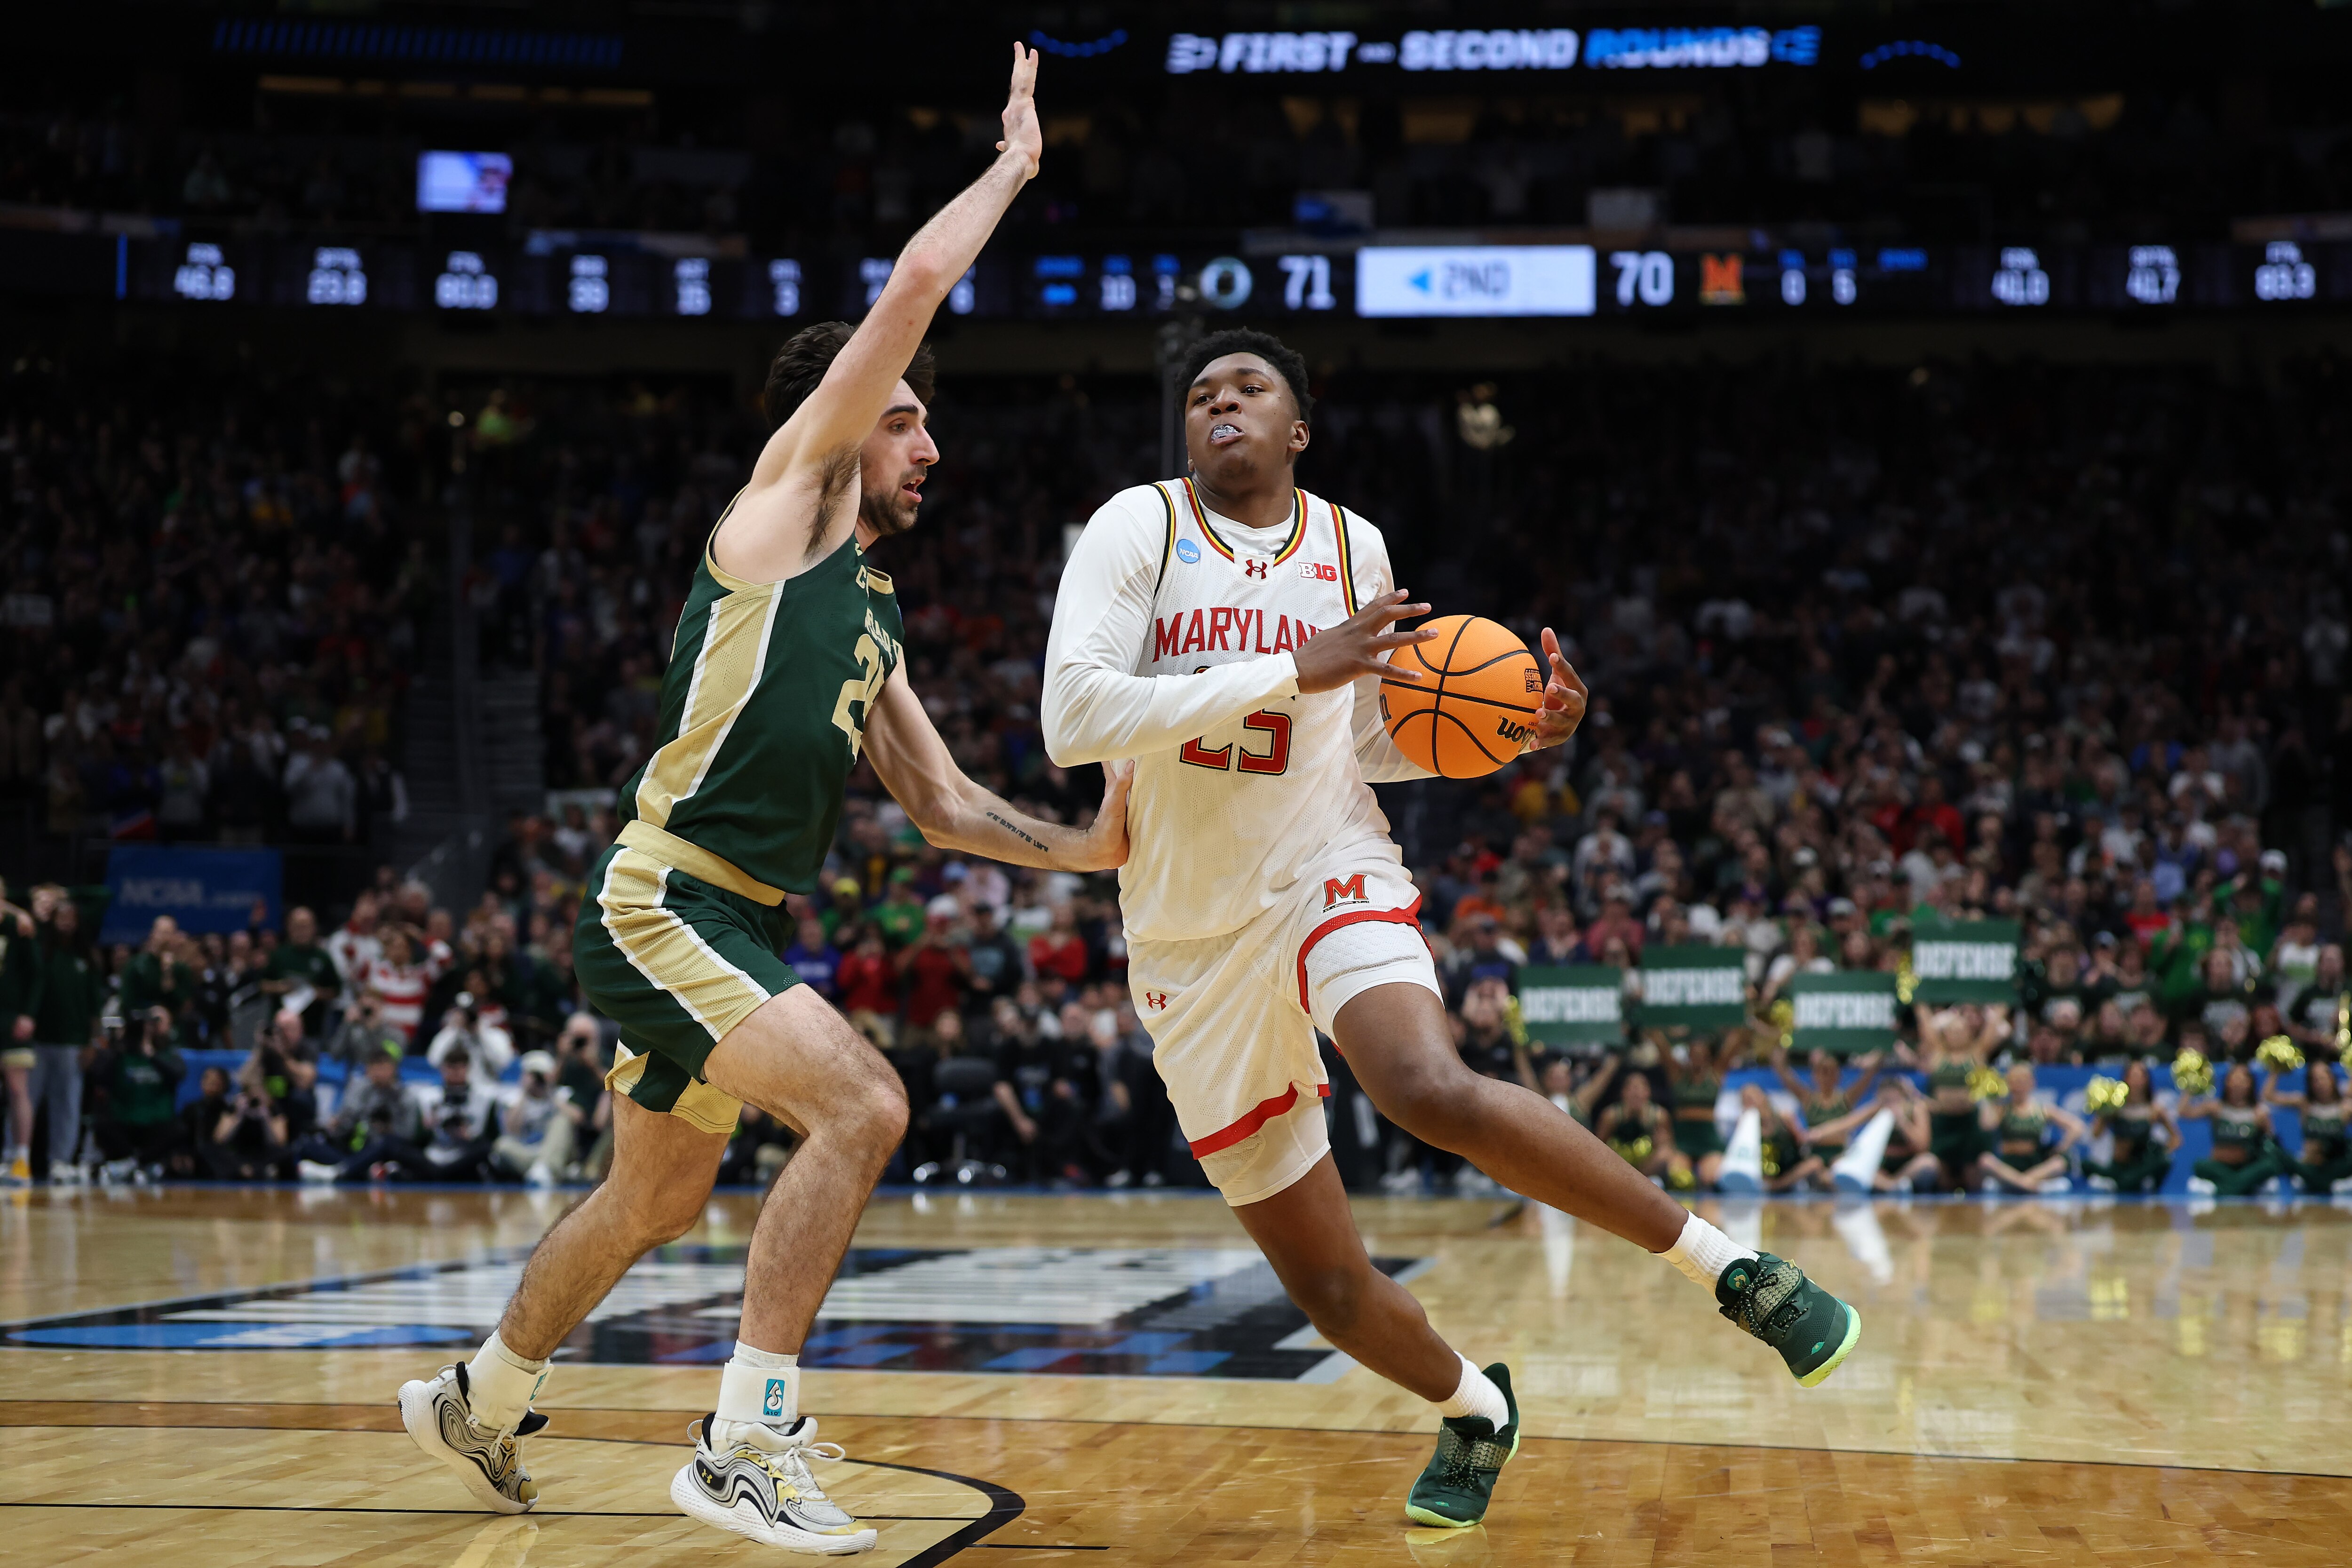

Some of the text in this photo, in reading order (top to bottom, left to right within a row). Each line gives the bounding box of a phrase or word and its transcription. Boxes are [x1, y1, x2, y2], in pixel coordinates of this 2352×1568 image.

[1218, 32, 1356, 72] FIRST
[1399, 29, 1579, 70] SECOND
[1584, 27, 1772, 69] ROUNDS
[1279, 255, 1335, 309] 71
[1442, 261, 1510, 298] 2ND
[1610, 252, 1674, 306] 70
[1179, 549, 1199, 559] NCAA
[1152, 607, 1323, 663] MARYLAN
[1323, 873, 1369, 908] M
[1912, 941, 2017, 980] DEFENSE
[1520, 986, 1621, 1023] DEFENSE
[1644, 966, 1744, 1005] DEFENSE
[1793, 991, 1896, 1029] DEFENSE
